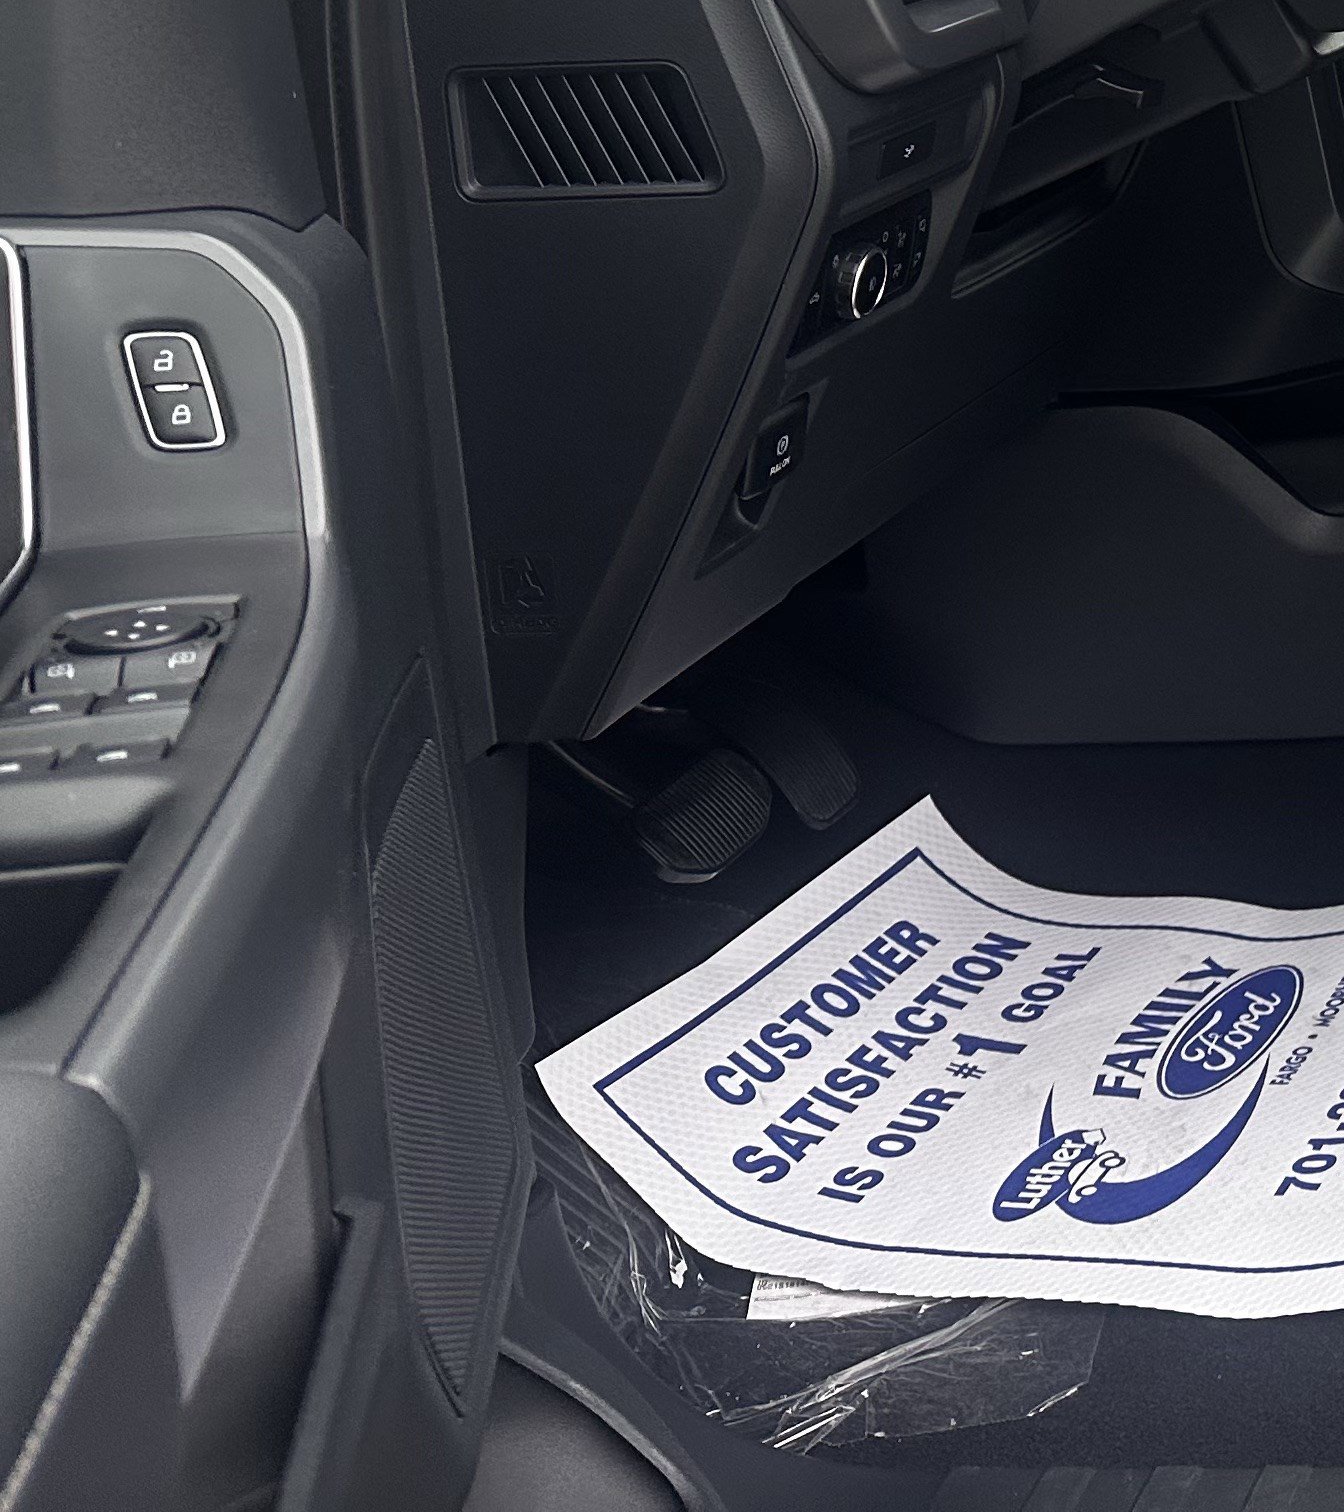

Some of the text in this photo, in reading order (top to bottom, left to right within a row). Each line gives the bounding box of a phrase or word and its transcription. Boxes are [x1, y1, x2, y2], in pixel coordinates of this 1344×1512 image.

[704, 920, 941, 1105] CUSTOMER
[732, 932, 1032, 1183] SATISFACTION
[817, 946, 1102, 1203] IS OUR #1 GOAL
[1093, 956, 1240, 1099] FAMILY
[1181, 991, 1283, 1071] Ford
[1269, 1045, 1314, 1086] FARGO
[1000, 1137, 1087, 1211] Luther
